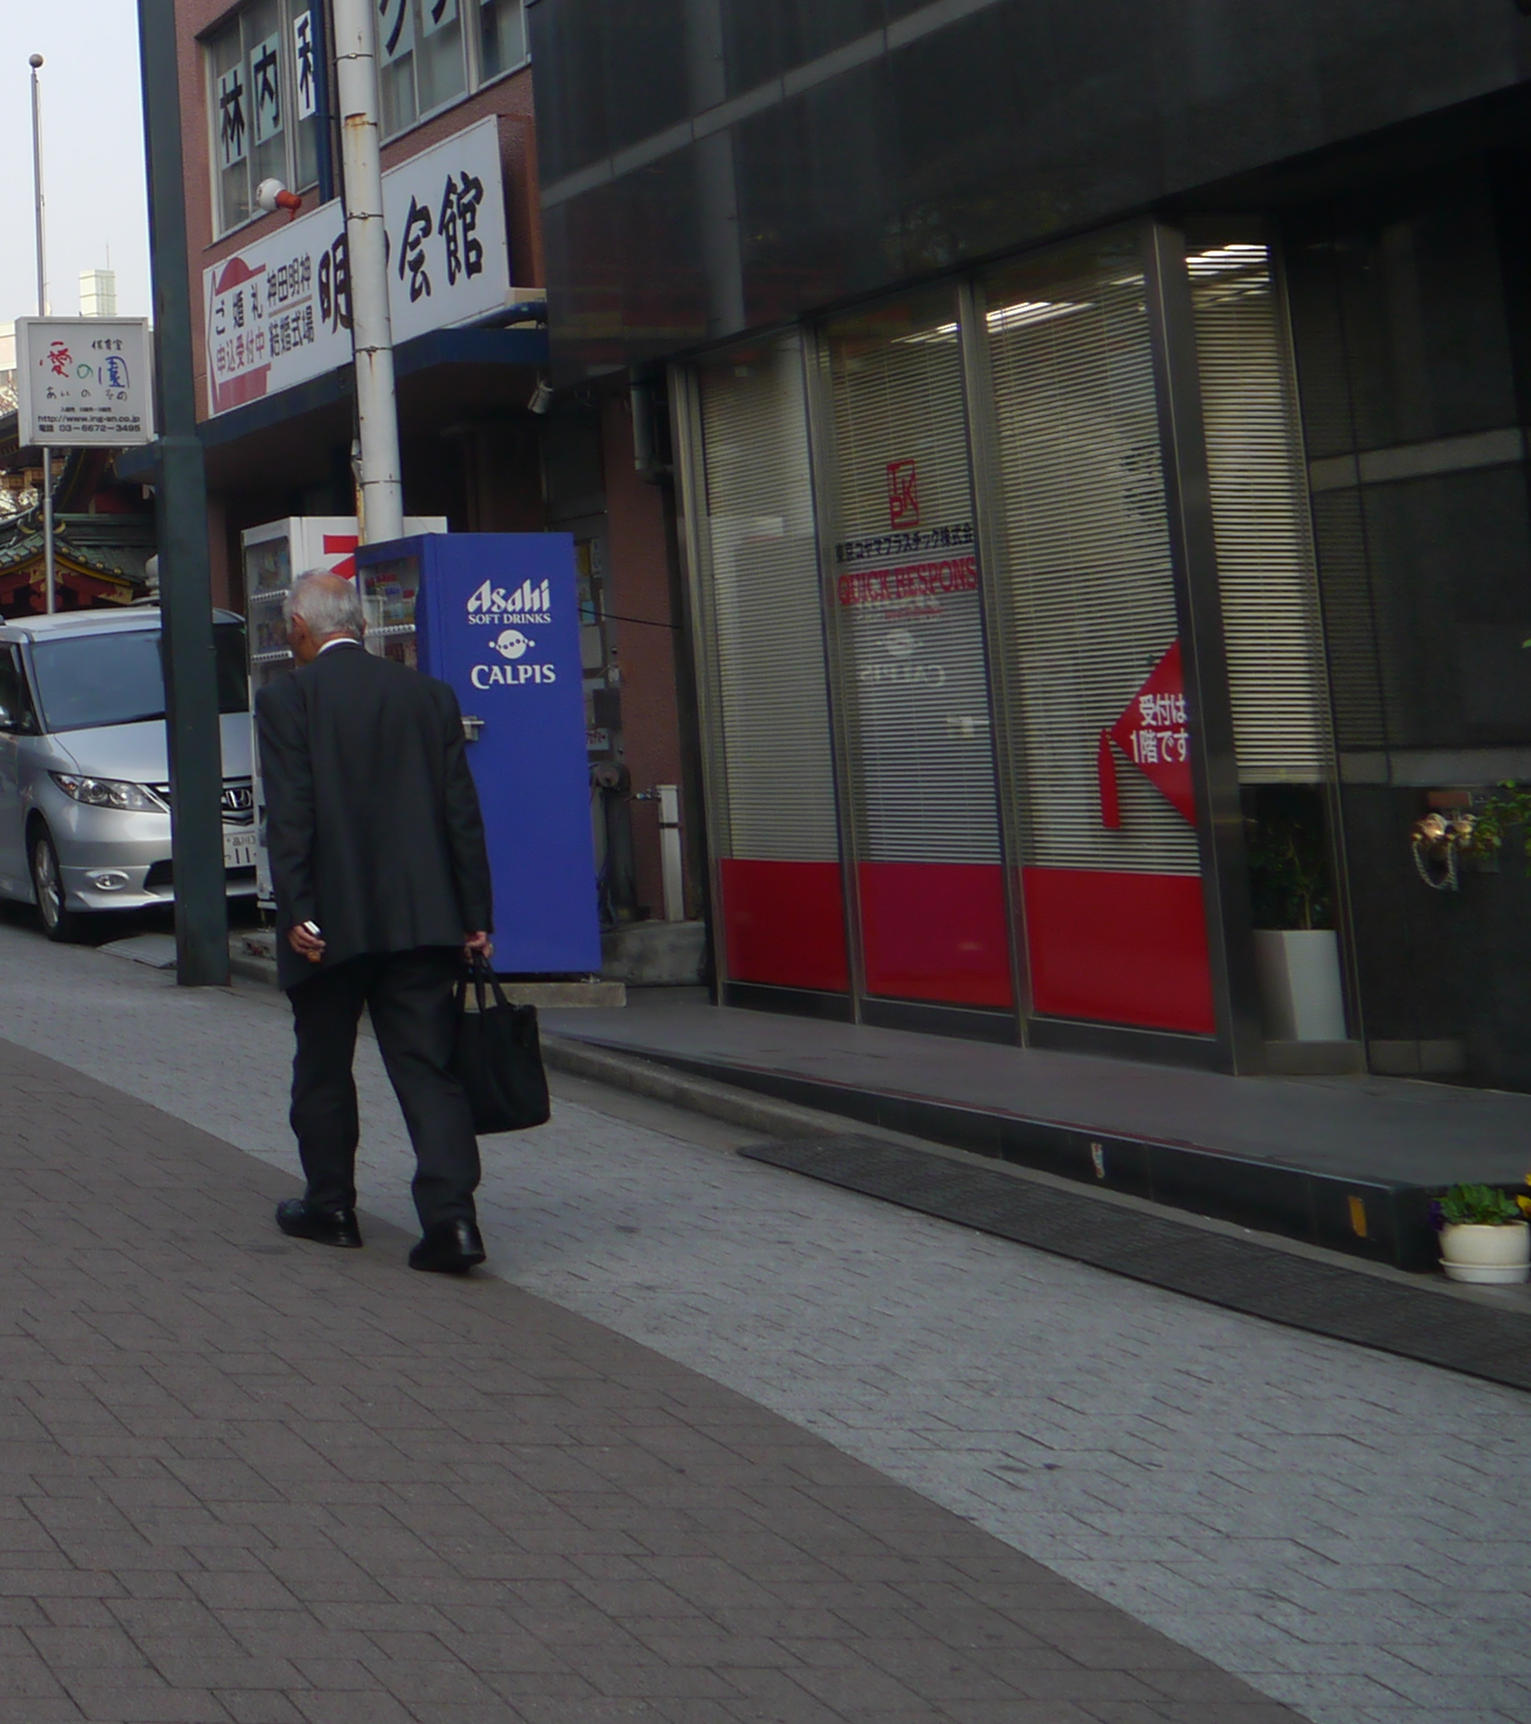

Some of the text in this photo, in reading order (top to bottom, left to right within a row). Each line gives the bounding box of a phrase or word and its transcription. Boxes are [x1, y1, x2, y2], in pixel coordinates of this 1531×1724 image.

[319, 170, 484, 334] 明会館
[267, 252, 312, 306] 神田明神
[216, 325, 265, 374] 申込受付中
[268, 305, 315, 358] 結婚式場
[467, 579, 550, 612] Asahi
[468, 613, 552, 624] SOFT DRINKS
[471, 664, 556, 689] CALPIS
[1139, 693, 1188, 726] 受付は
[1130, 727, 1188, 763] 1階です
